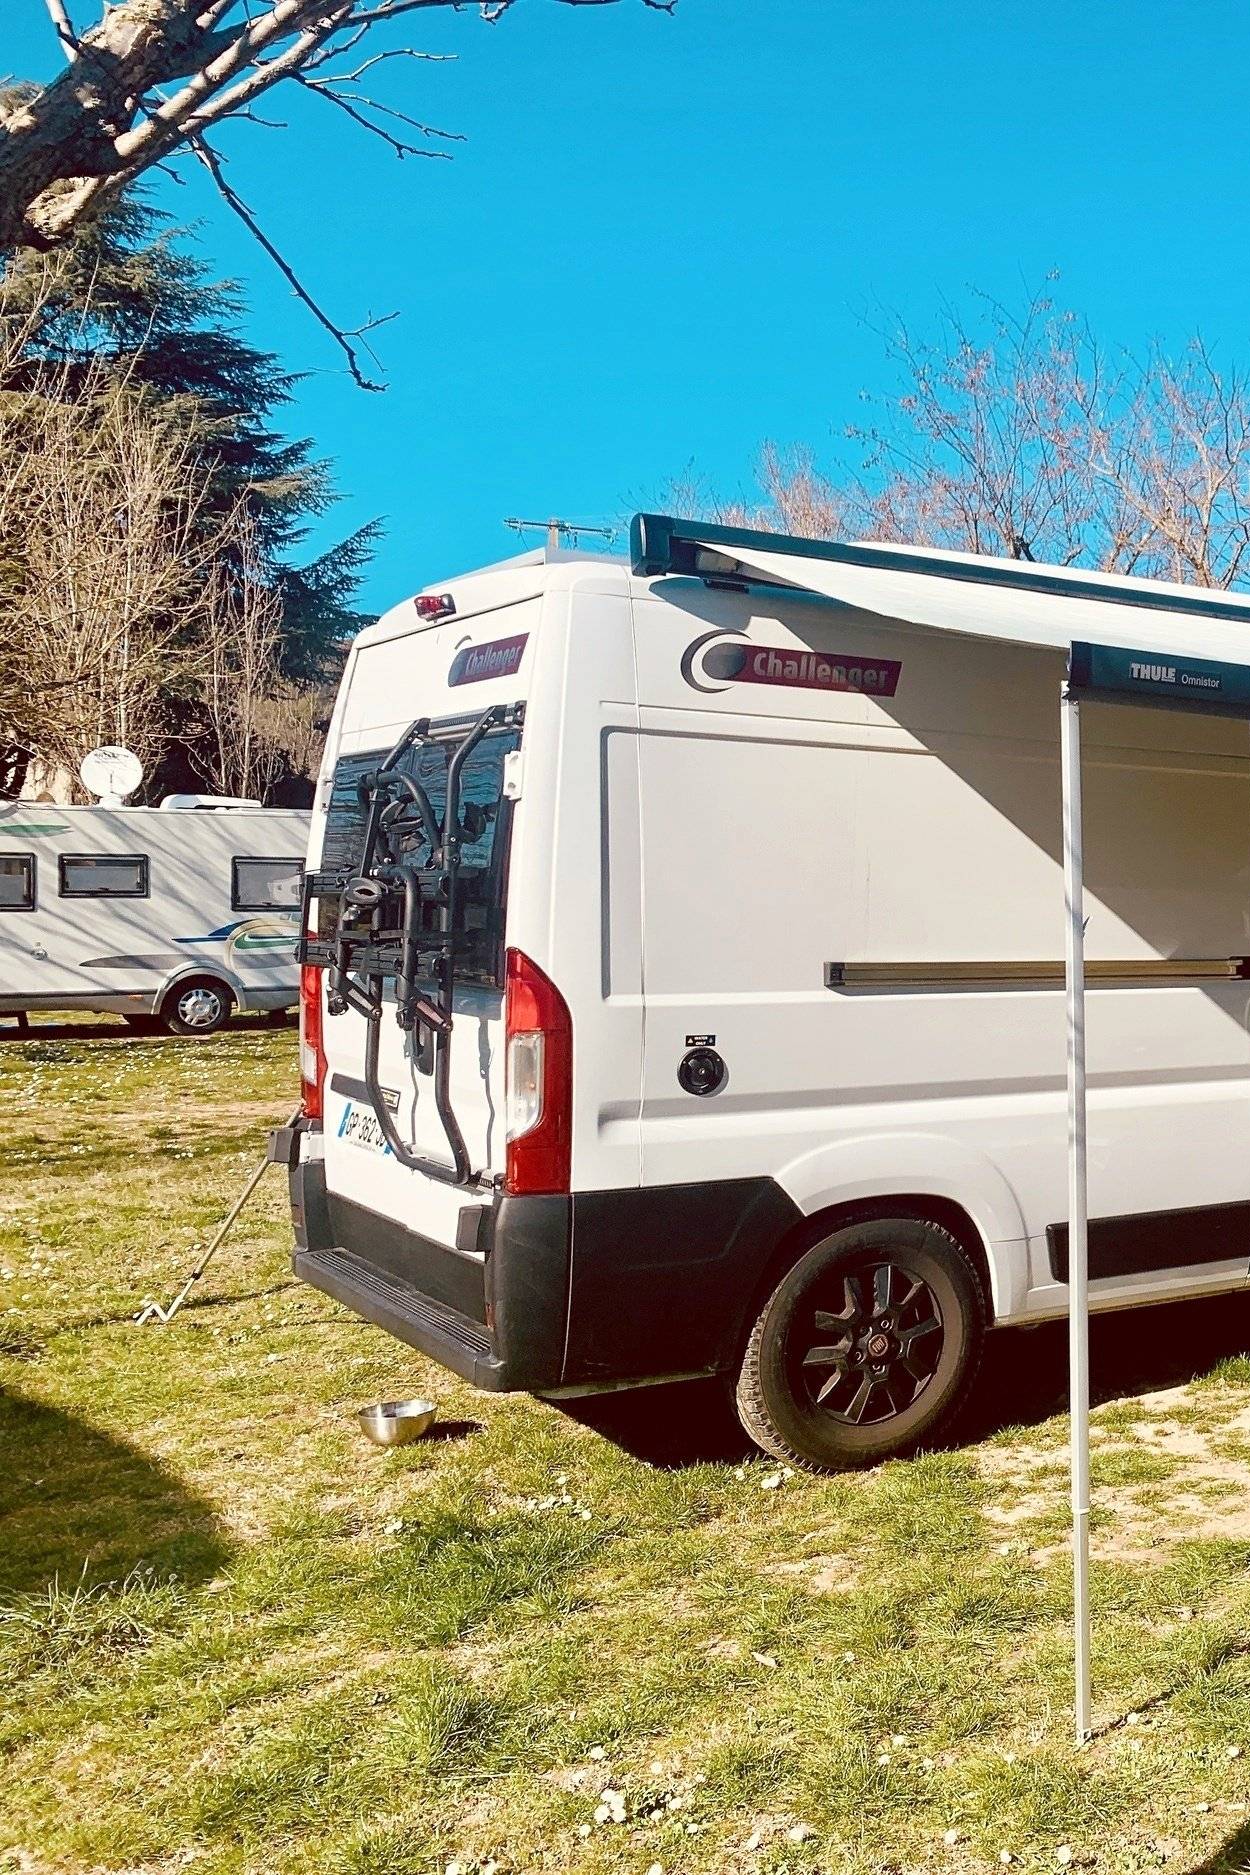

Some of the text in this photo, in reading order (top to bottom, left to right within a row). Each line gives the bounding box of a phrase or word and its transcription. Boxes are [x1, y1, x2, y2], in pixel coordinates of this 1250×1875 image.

[465, 643, 521, 676] Challenger
[753, 651, 889, 689] Challenger
[1131, 662, 1220, 688] THULE Omnistor
